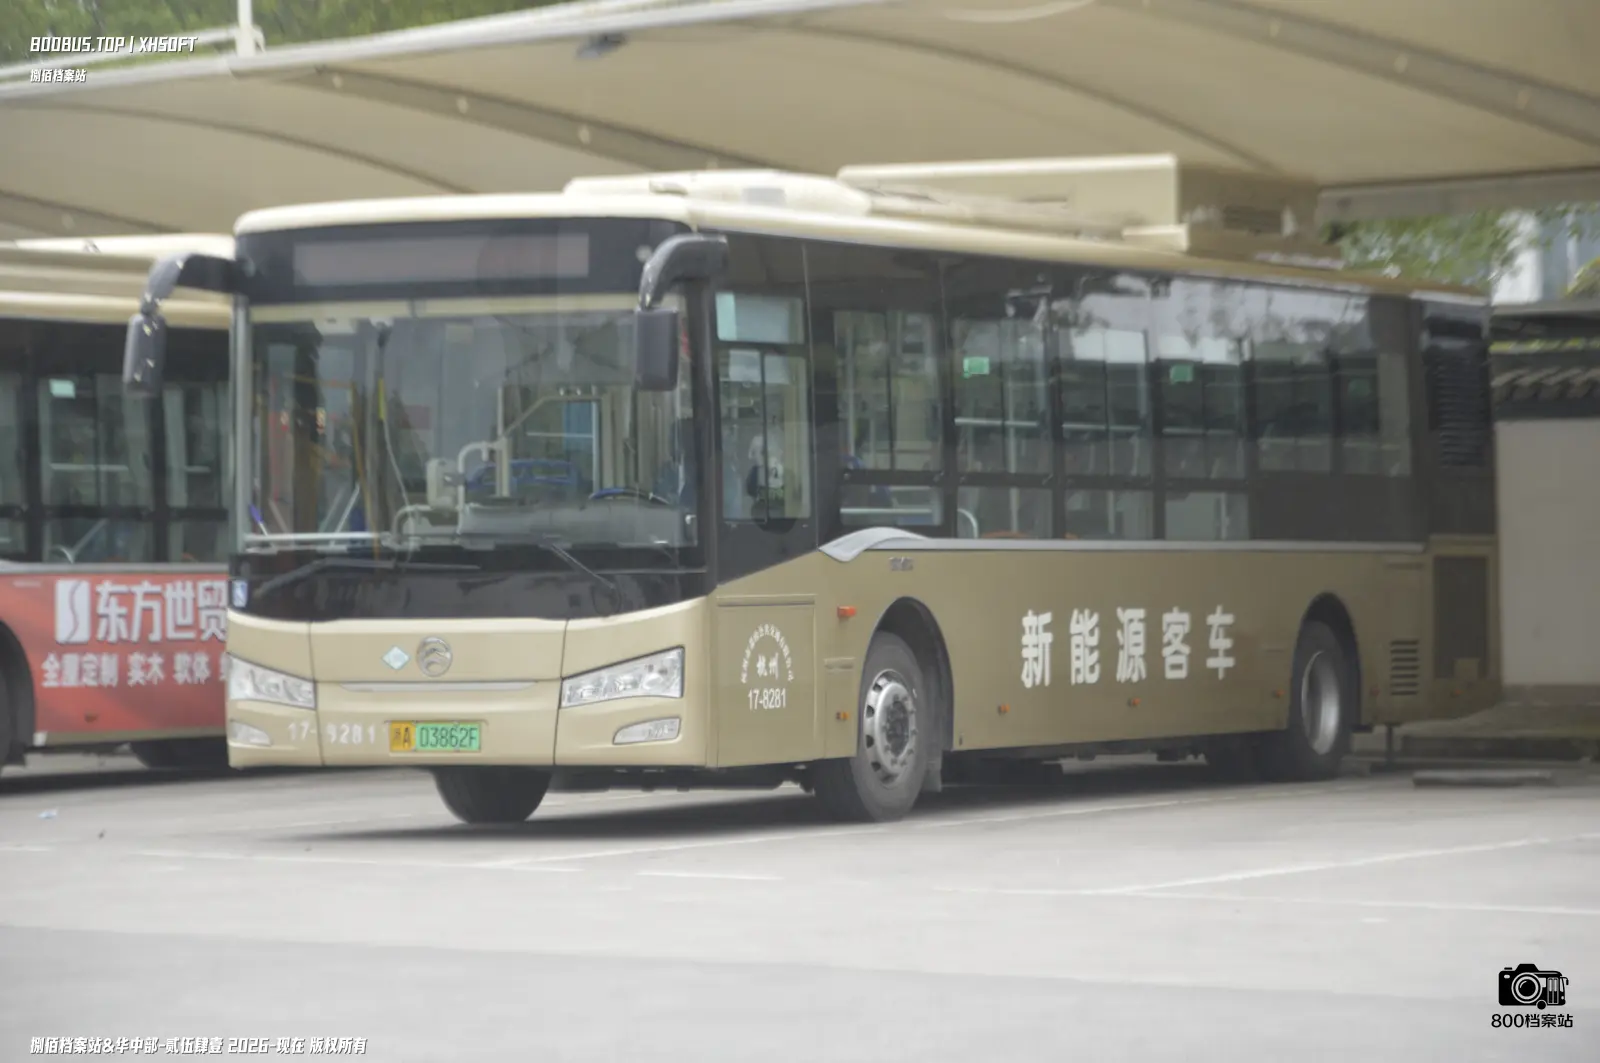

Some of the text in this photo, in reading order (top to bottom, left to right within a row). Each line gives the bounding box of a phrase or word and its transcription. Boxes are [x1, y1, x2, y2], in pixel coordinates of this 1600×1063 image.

[95, 580, 228, 642] 东方世贸
[1021, 604, 1236, 689] 新能源客车
[748, 687, 787, 711] 17-8281
